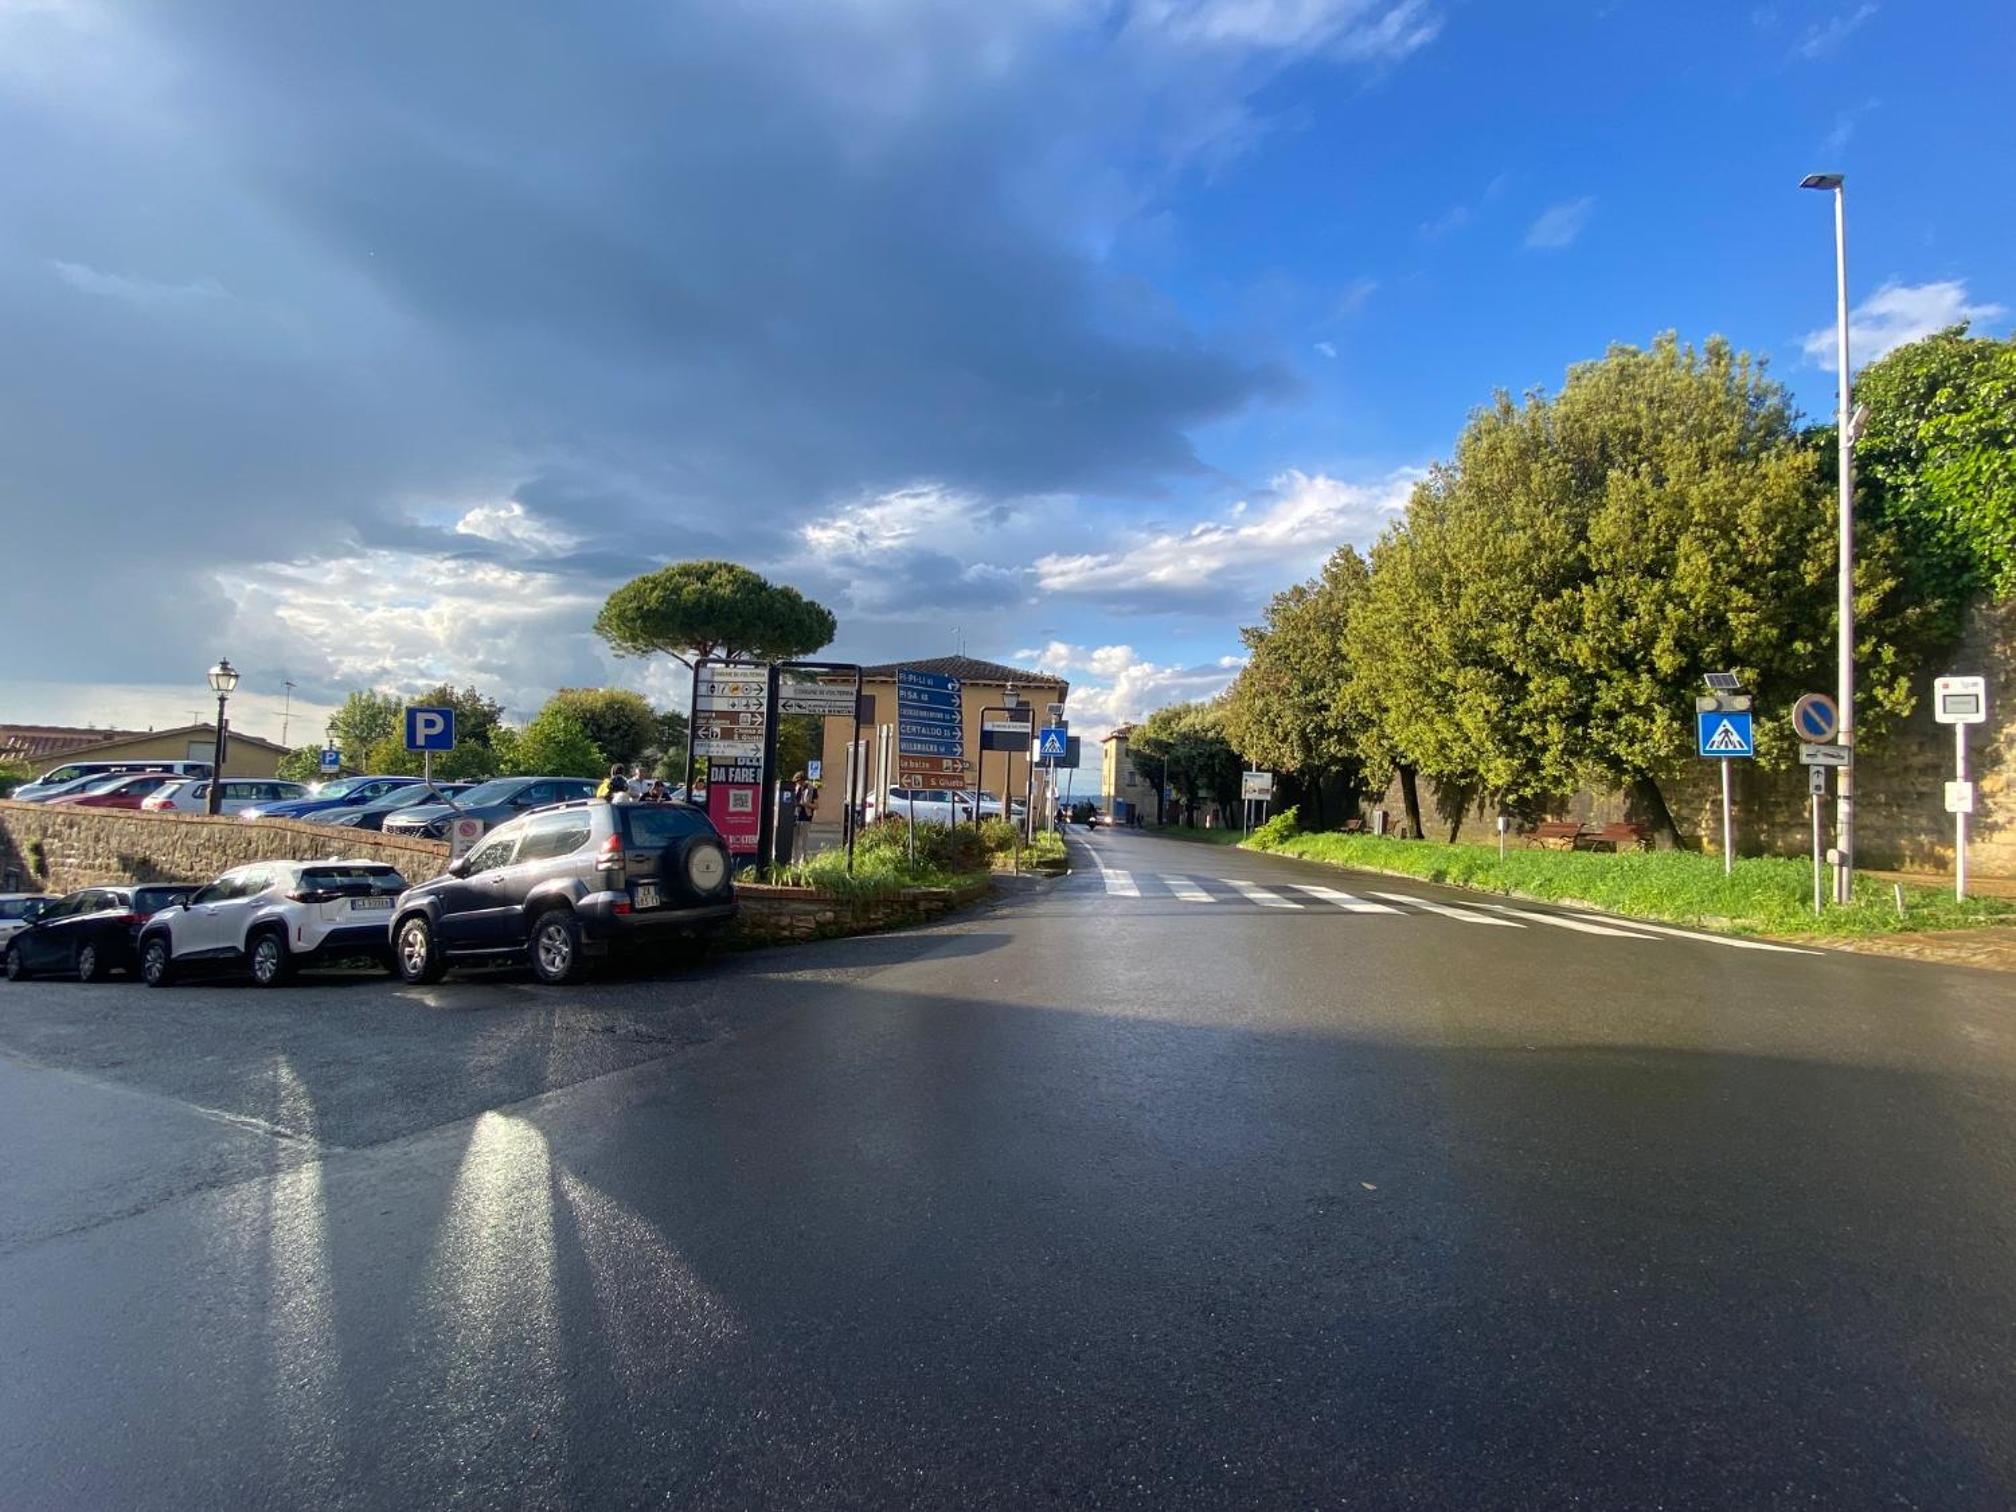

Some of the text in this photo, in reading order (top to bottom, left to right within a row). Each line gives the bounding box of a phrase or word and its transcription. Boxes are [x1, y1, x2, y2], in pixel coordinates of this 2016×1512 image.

[416, 711, 445, 746] P
[900, 724, 942, 736] CERTALDO
[324, 752, 336, 764] P
[710, 766, 726, 782] DA
[728, 767, 755, 783] FARE
